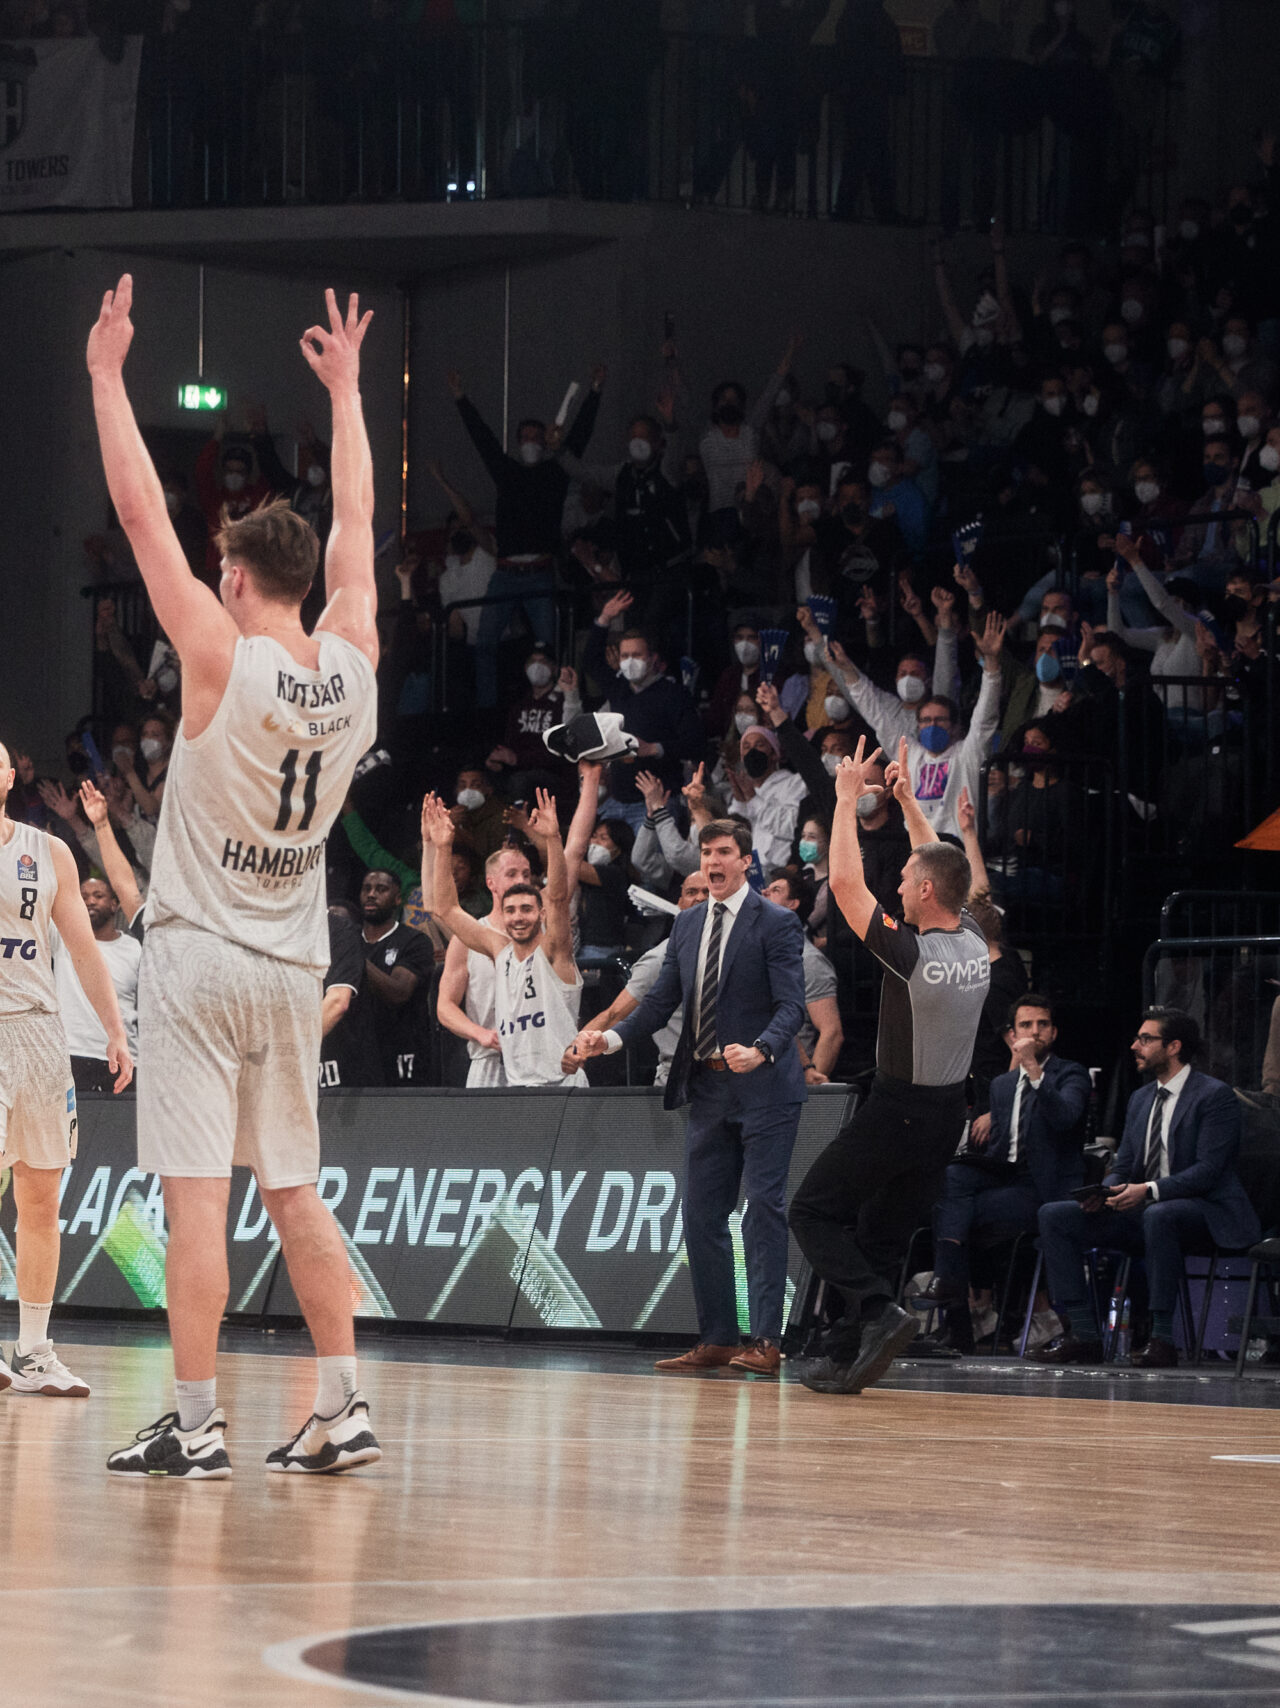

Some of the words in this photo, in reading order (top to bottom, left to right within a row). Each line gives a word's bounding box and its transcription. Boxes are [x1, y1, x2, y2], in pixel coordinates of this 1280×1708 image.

[7, 155, 69, 178] TOWERS
[308, 715, 352, 736] BLACK
[273, 748, 323, 831] 11
[221, 837, 327, 877] HAMBUR
[19, 887, 38, 921] 8
[524, 974, 537, 1000] 3
[396, 1053, 415, 1079] 17
[352, 1166, 587, 1251] ENERGY
